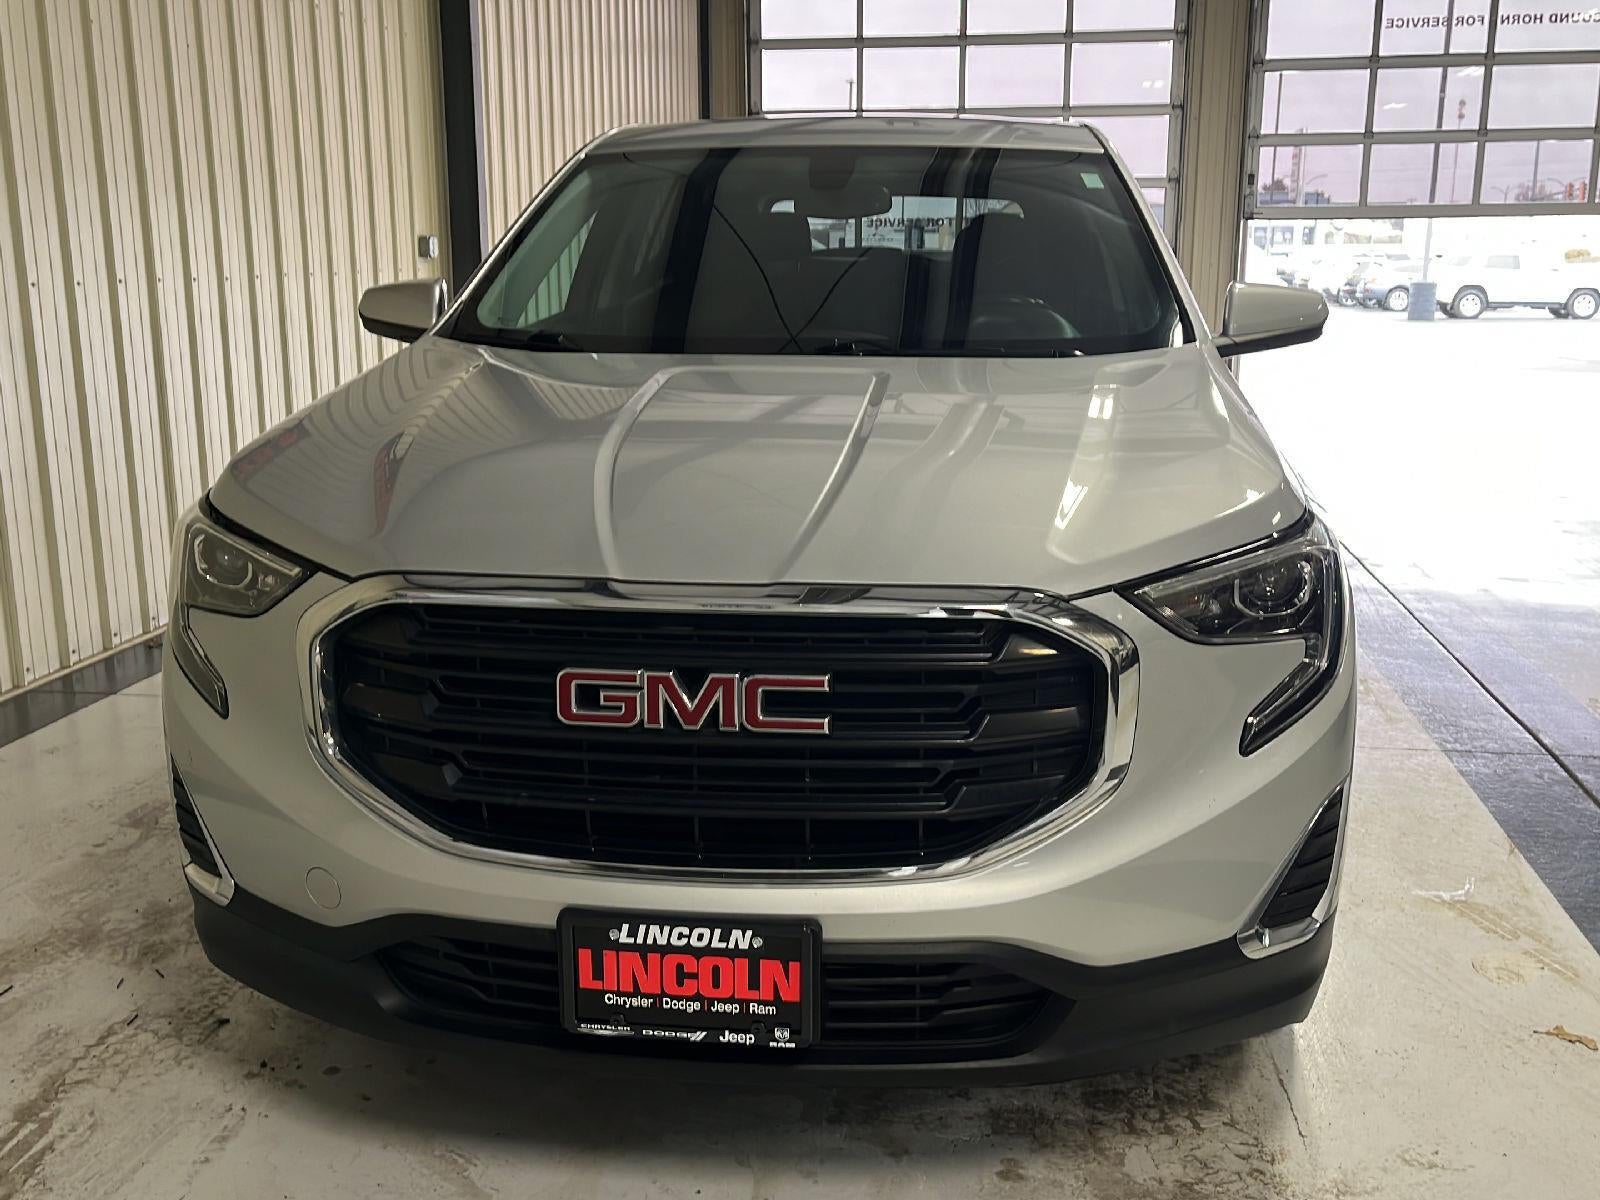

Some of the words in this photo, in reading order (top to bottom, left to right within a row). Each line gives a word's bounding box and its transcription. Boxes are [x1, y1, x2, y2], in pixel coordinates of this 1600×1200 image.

[556, 667, 831, 734] GMC
[619, 923, 752, 949] LINCOLN
[578, 947, 800, 1003] LINCOLN
[604, 993, 653, 1009] Chrysler
[662, 998, 701, 1012] Dodge
[711, 1002, 740, 1015] Jeep
[750, 1003, 776, 1015] Ram
[719, 1029, 755, 1046] Jeep
